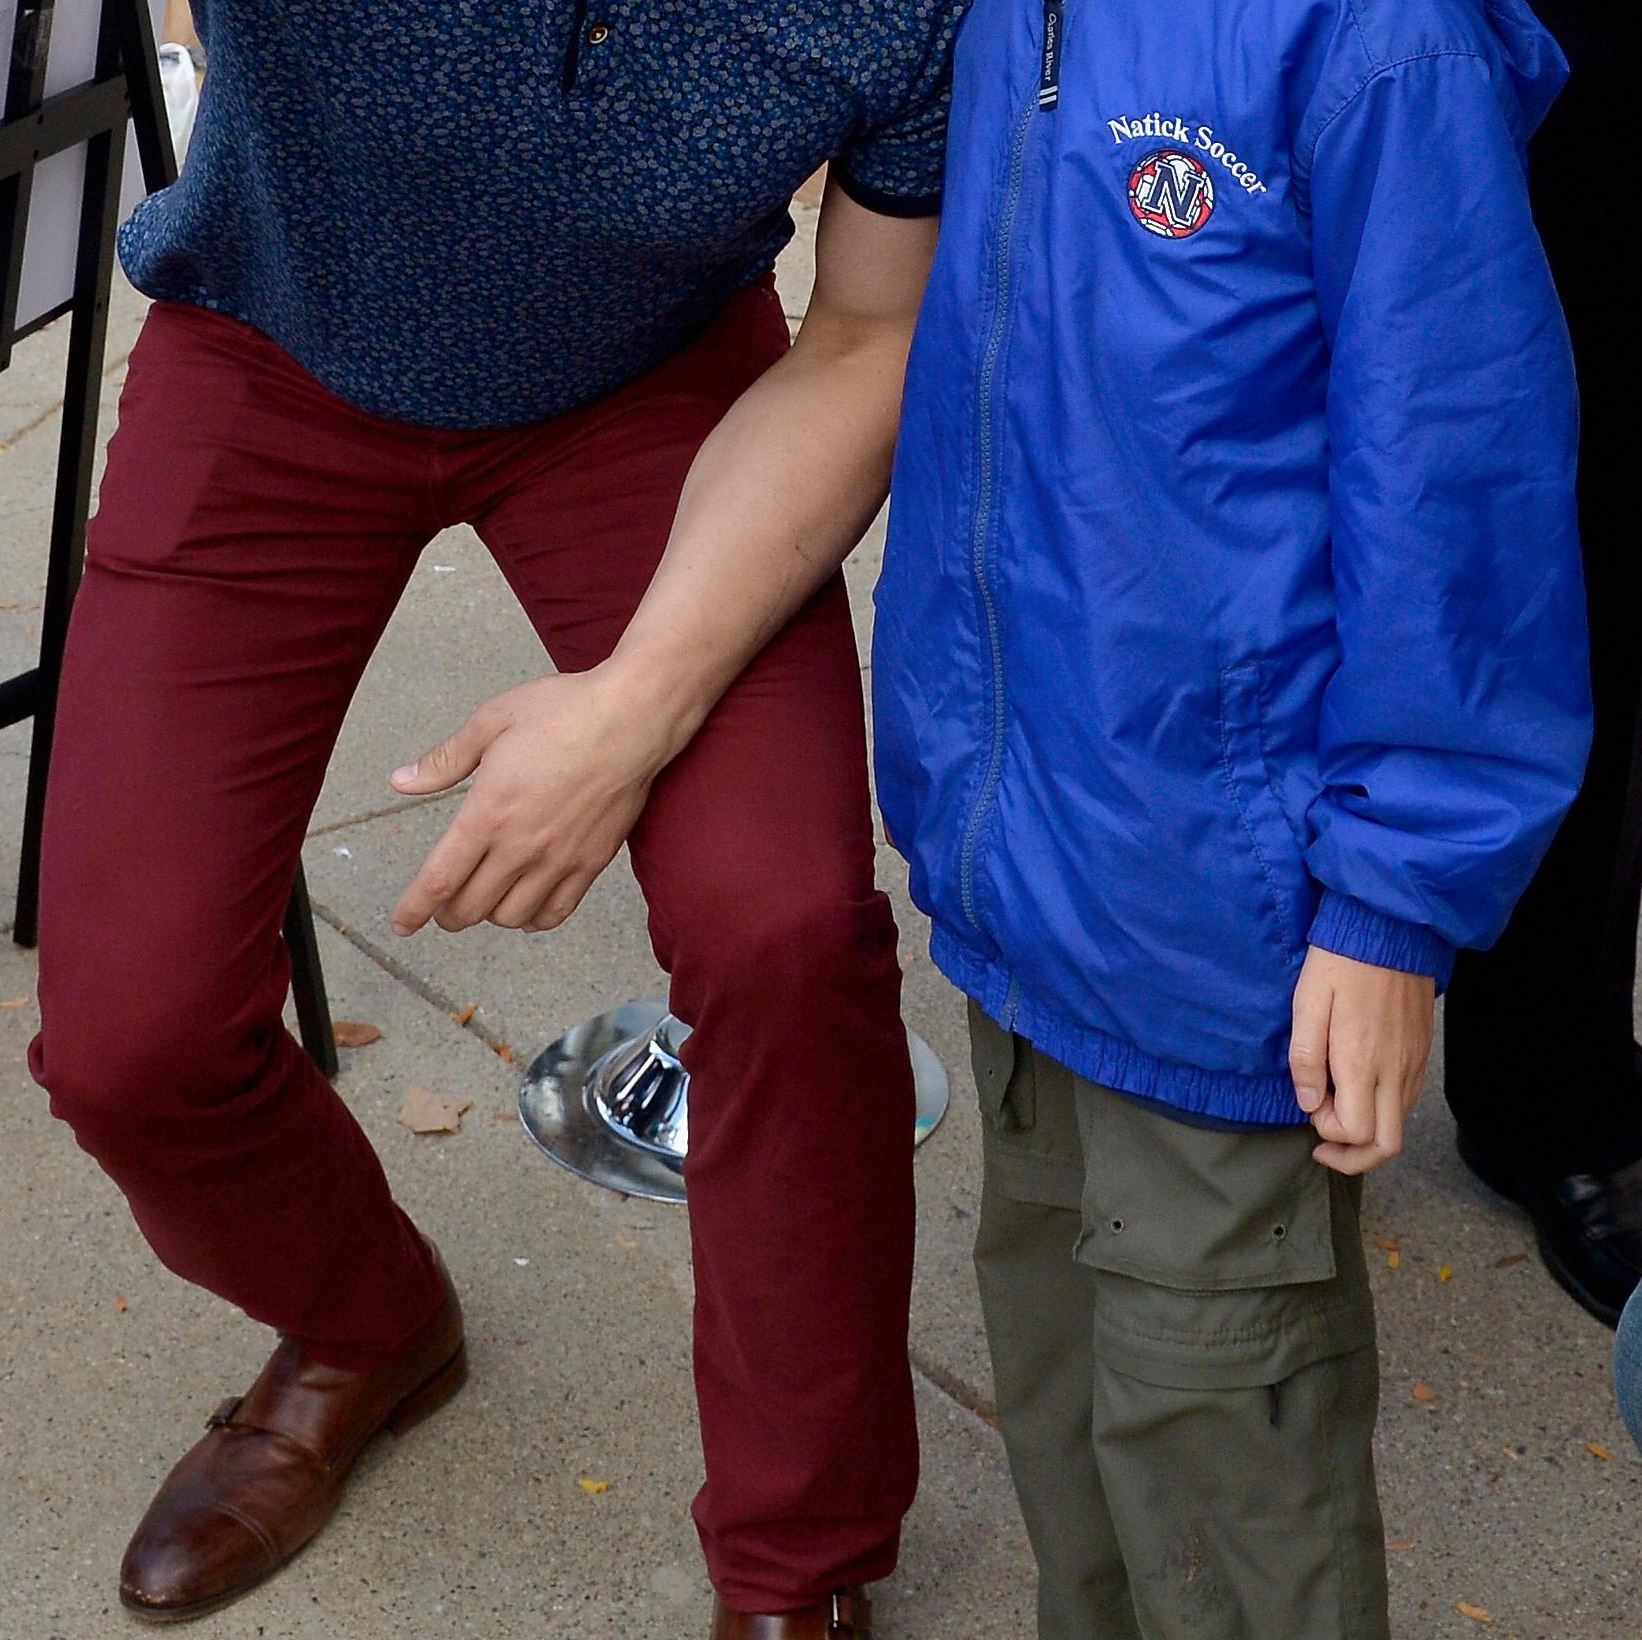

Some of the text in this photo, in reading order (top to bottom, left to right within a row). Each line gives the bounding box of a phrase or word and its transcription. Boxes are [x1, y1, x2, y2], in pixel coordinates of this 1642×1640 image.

[1107, 112, 1267, 195] Natick Soccer
[1142, 160, 1205, 228] N
